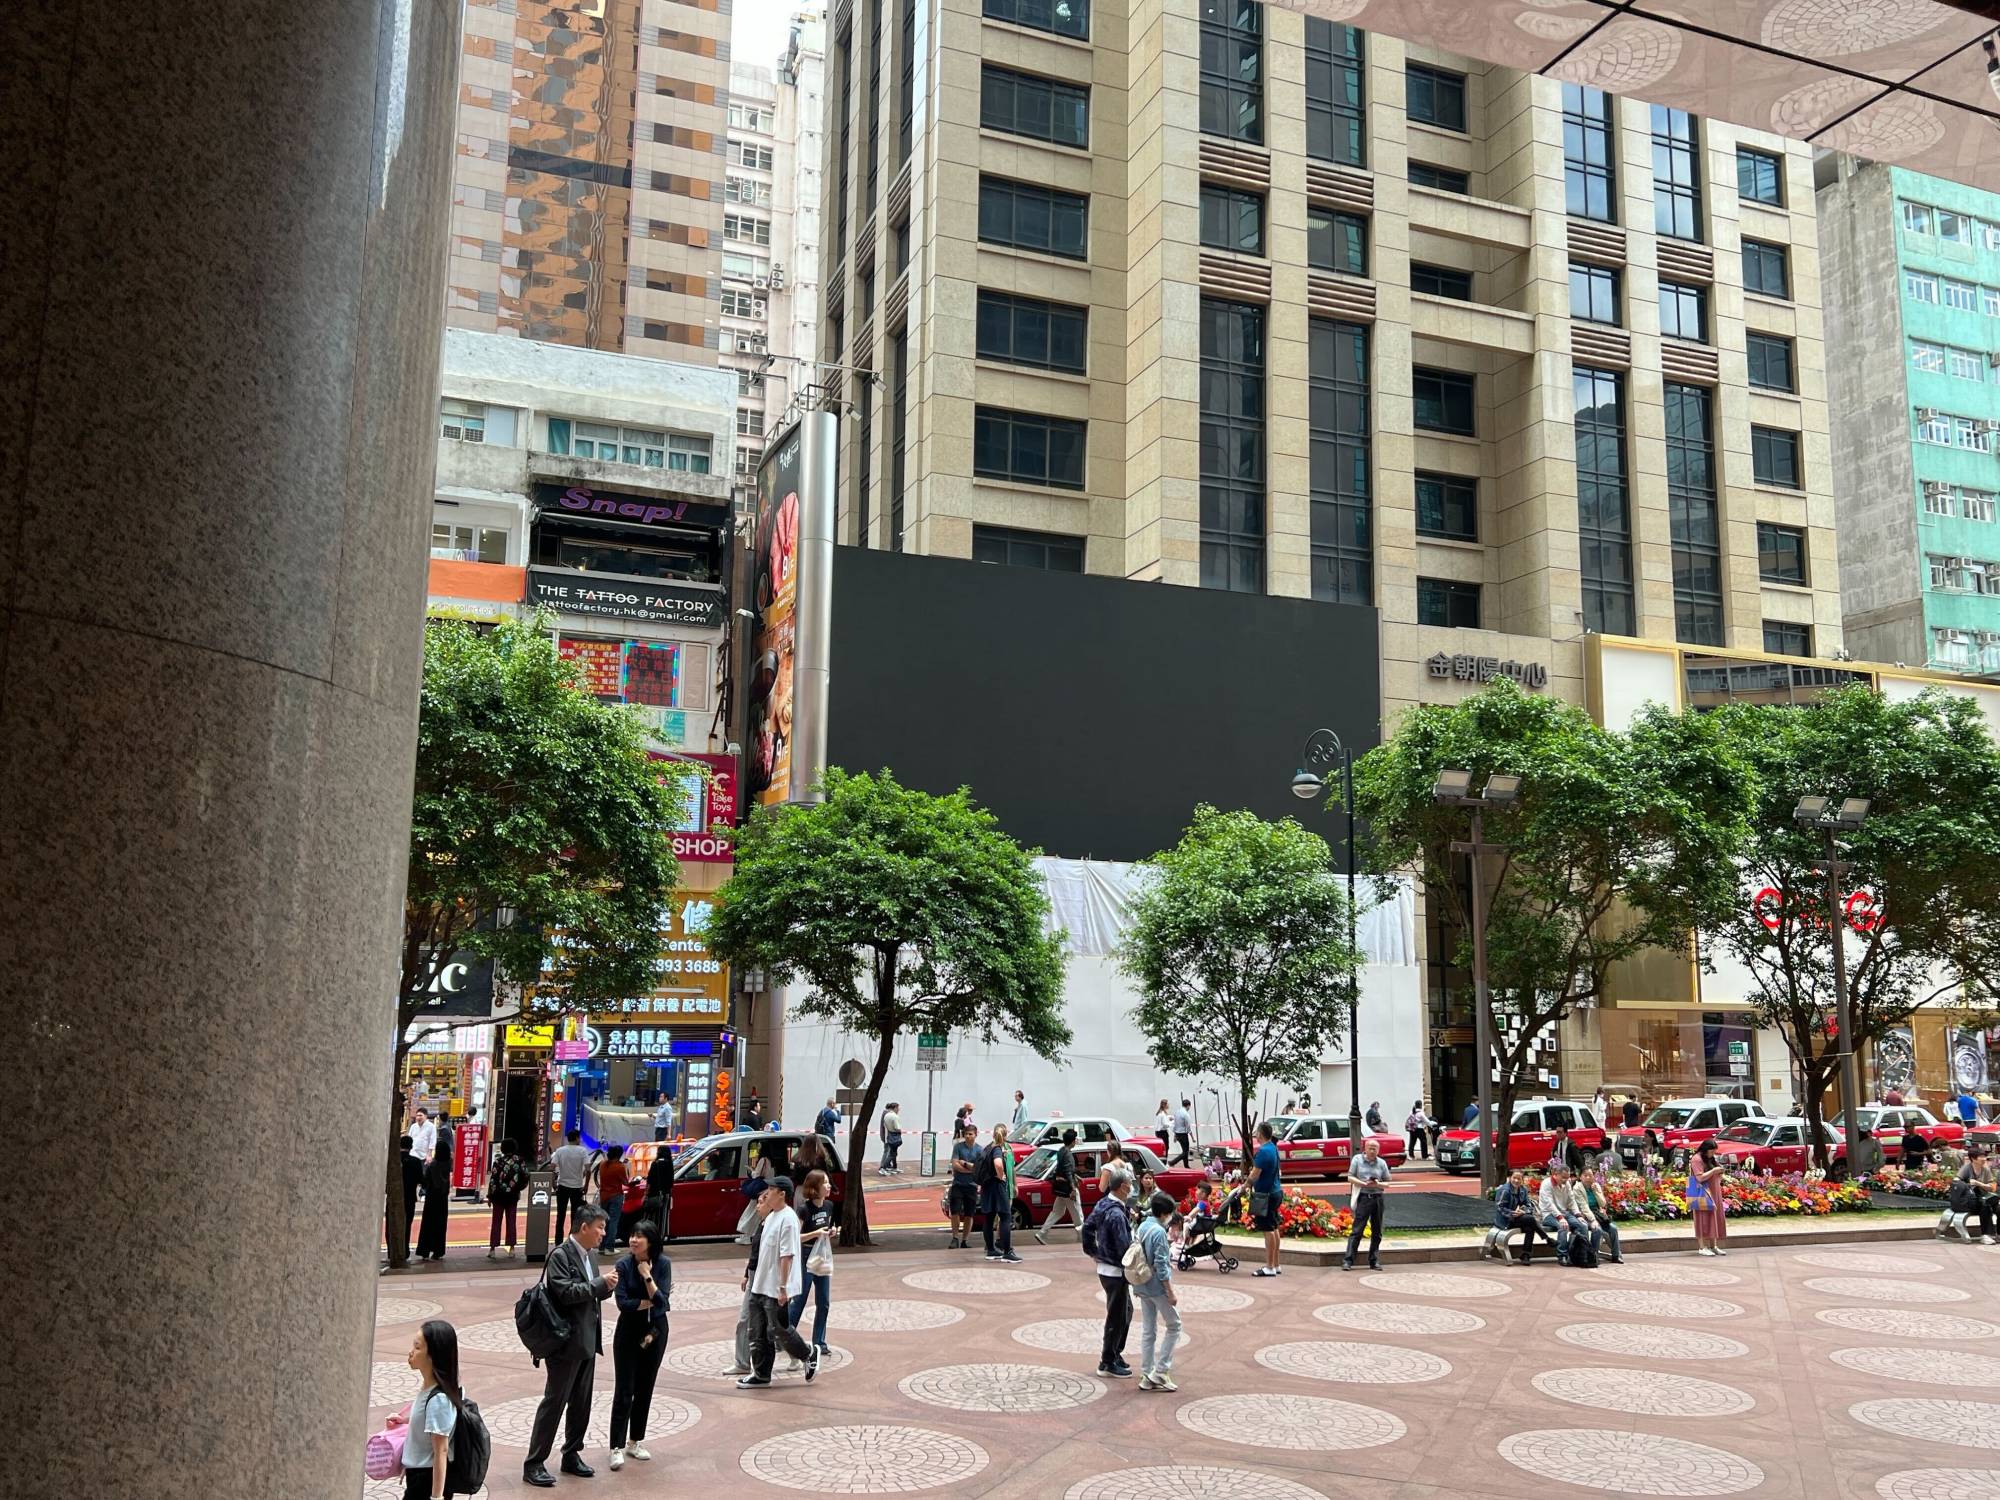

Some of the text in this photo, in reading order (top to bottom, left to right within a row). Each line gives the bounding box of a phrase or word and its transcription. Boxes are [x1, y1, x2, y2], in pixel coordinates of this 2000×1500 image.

[559, 486, 688, 523] Snap!
[537, 584, 714, 613] THE TATTOO FACTORY
[543, 599, 706, 623] tattoofactory.hk@gmail.com
[1427, 650, 1547, 688] 金朝陽中心
[712, 793, 733, 803] Take
[712, 802, 732, 814] Toys
[672, 837, 729, 857] SHOP
[685, 959, 721, 973] 3688
[653, 998, 679, 1012] 保養
[682, 998, 721, 1012] 配電池
[608, 1043, 670, 1055] CHANGE
